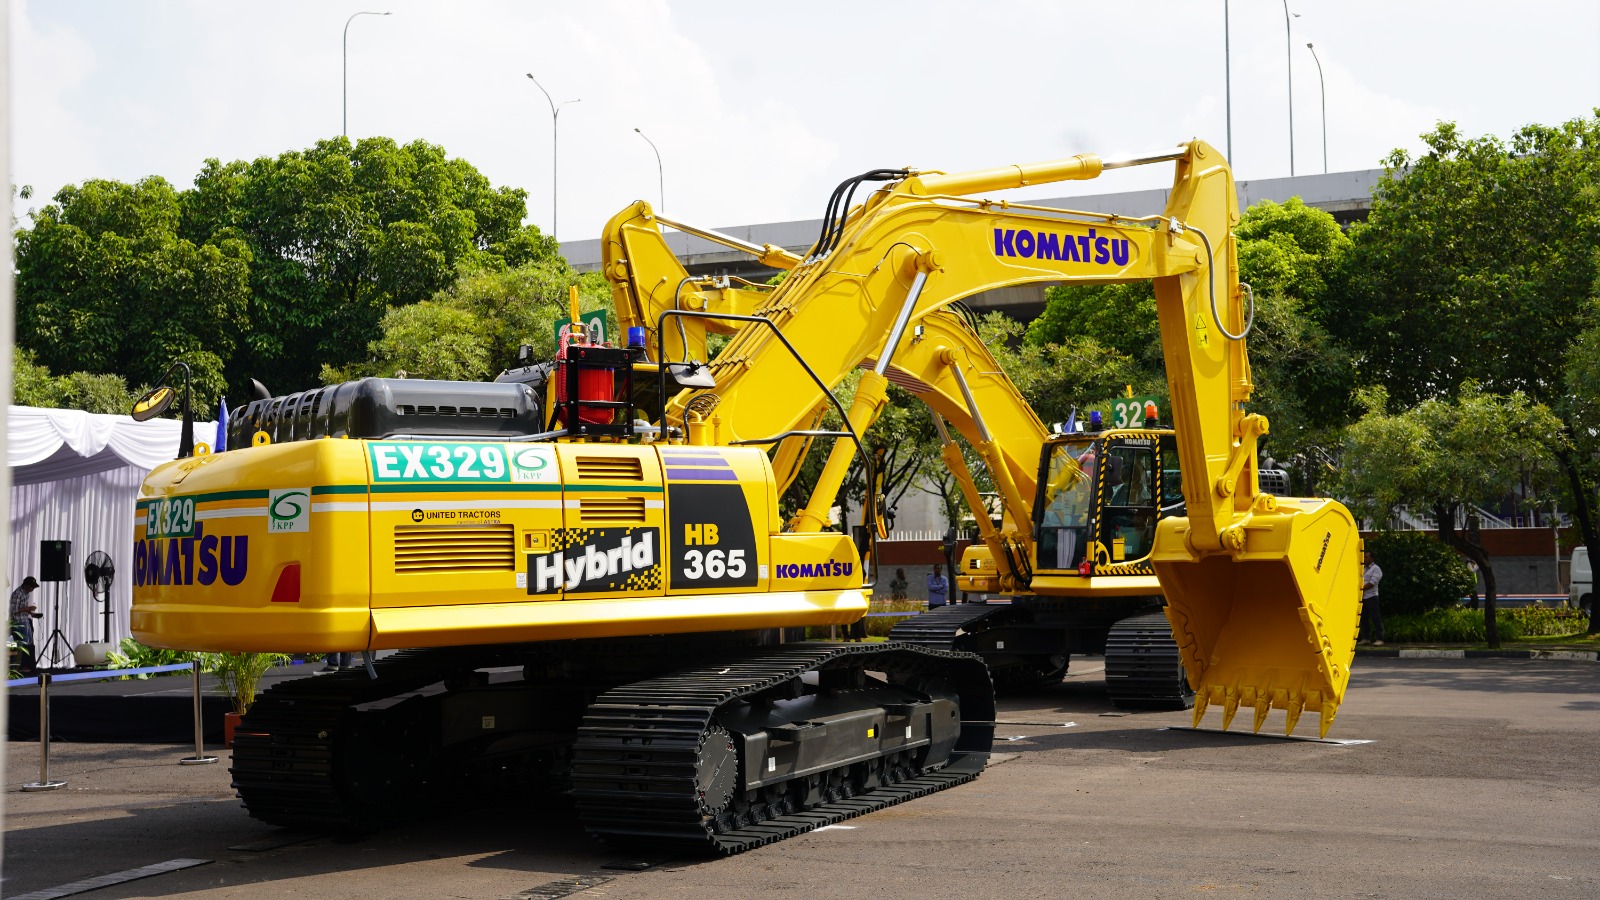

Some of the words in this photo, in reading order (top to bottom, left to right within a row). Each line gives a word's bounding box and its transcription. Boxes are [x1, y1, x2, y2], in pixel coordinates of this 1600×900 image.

[994, 228, 1129, 266] KOMATSU
[1115, 400, 1156, 428] 32
[373, 444, 505, 479] EX329
[523, 472, 542, 480] KPP
[147, 498, 194, 536] EX329
[277, 522, 294, 530] KPP
[426, 511, 456, 519] UNITED
[684, 523, 719, 546] HB
[536, 531, 654, 592] Hybrid
[683, 550, 747, 580] 365
[776, 559, 852, 578] KOMATSU
